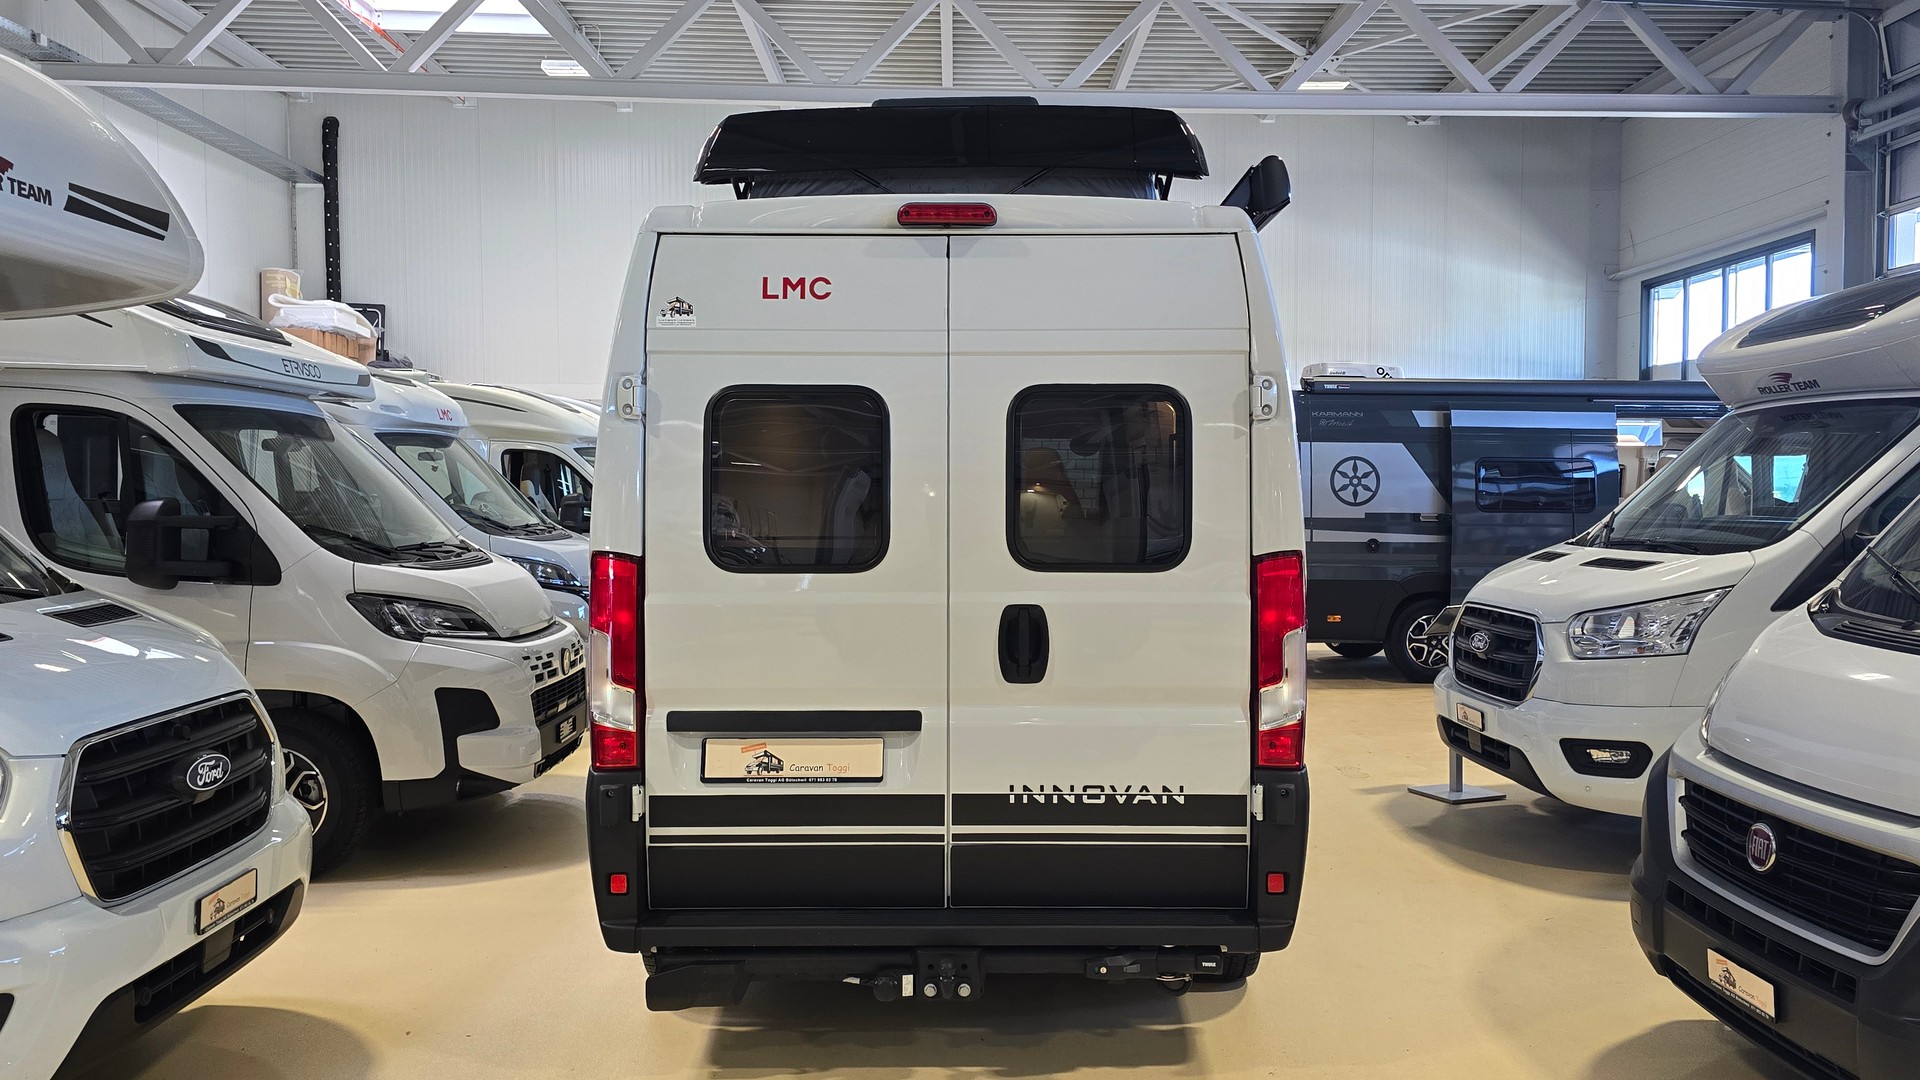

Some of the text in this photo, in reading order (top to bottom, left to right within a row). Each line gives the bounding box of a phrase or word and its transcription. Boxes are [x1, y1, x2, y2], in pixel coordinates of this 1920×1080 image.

[6, 176, 53, 206] TEAM
[762, 276, 832, 300] LMC
[1757, 379, 1821, 396] ROLLER TEAM
[436, 408, 453, 421] LMC
[197, 759, 224, 786] Ford
[789, 763, 851, 774] Caravan Toggi
[1009, 784, 1185, 805] INNOVAN
[1751, 835, 1770, 861] FIAT
